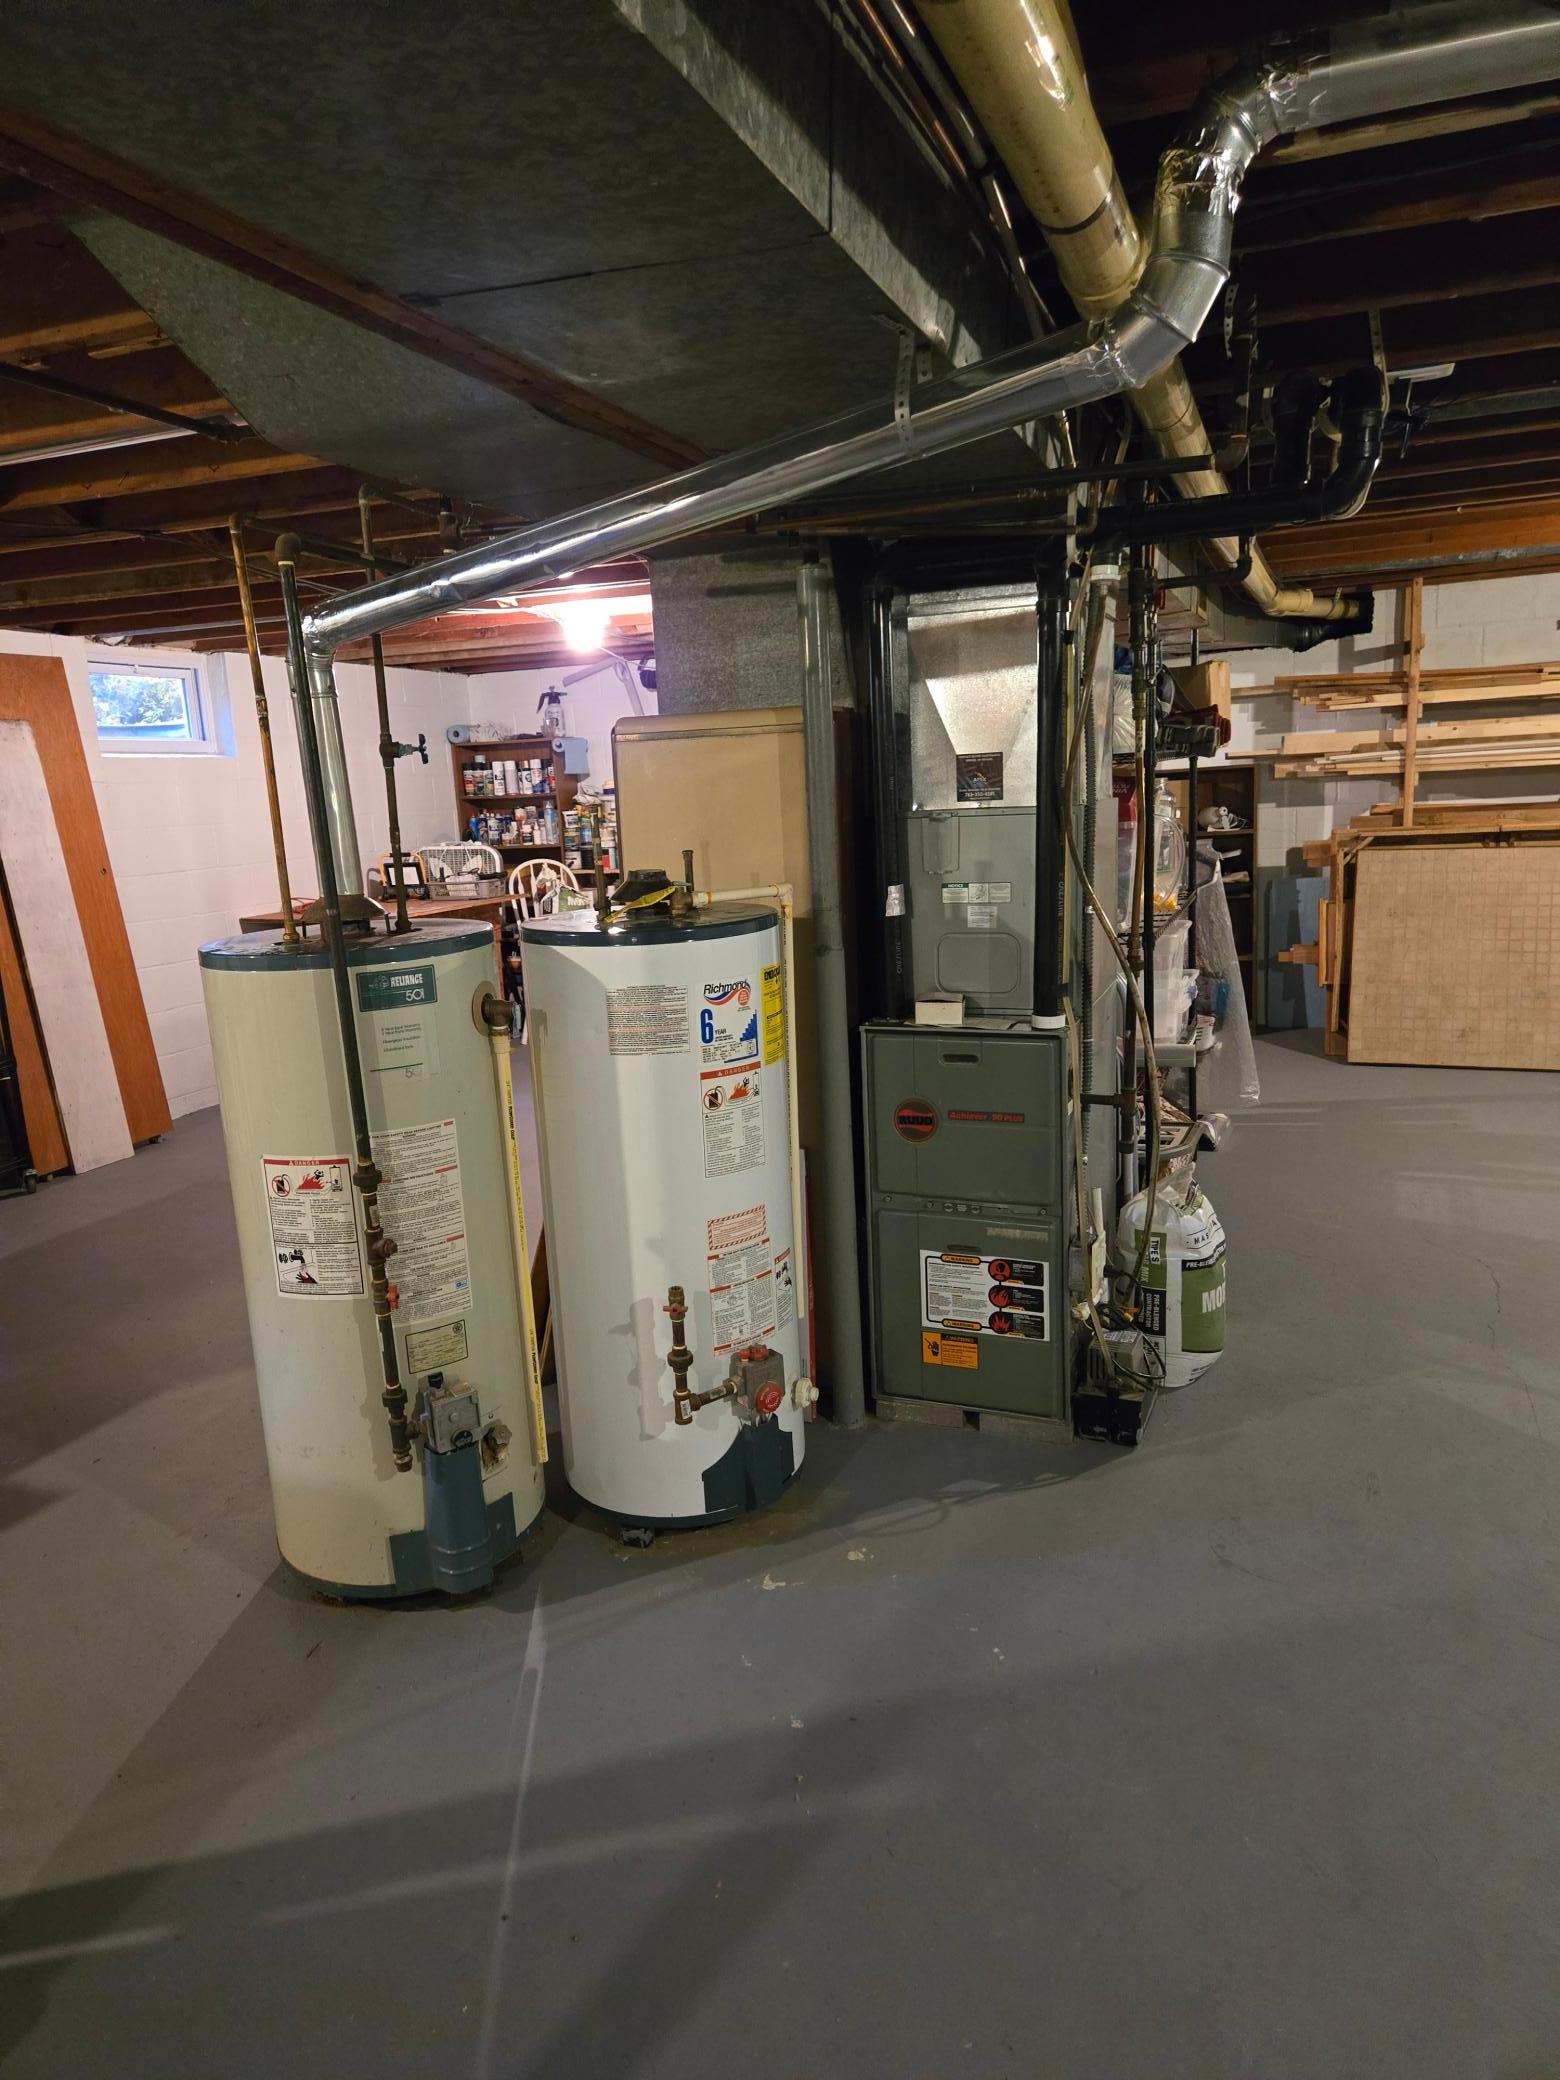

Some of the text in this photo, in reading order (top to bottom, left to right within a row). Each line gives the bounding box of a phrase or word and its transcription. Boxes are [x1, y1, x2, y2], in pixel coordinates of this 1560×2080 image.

[390, 973, 423, 988] RELIANCE
[704, 978, 748, 994] Richmond
[700, 1008, 714, 1044] 6
[900, 1116, 933, 1125] RUUD
[1150, 1240, 1160, 1265] TYPE S
